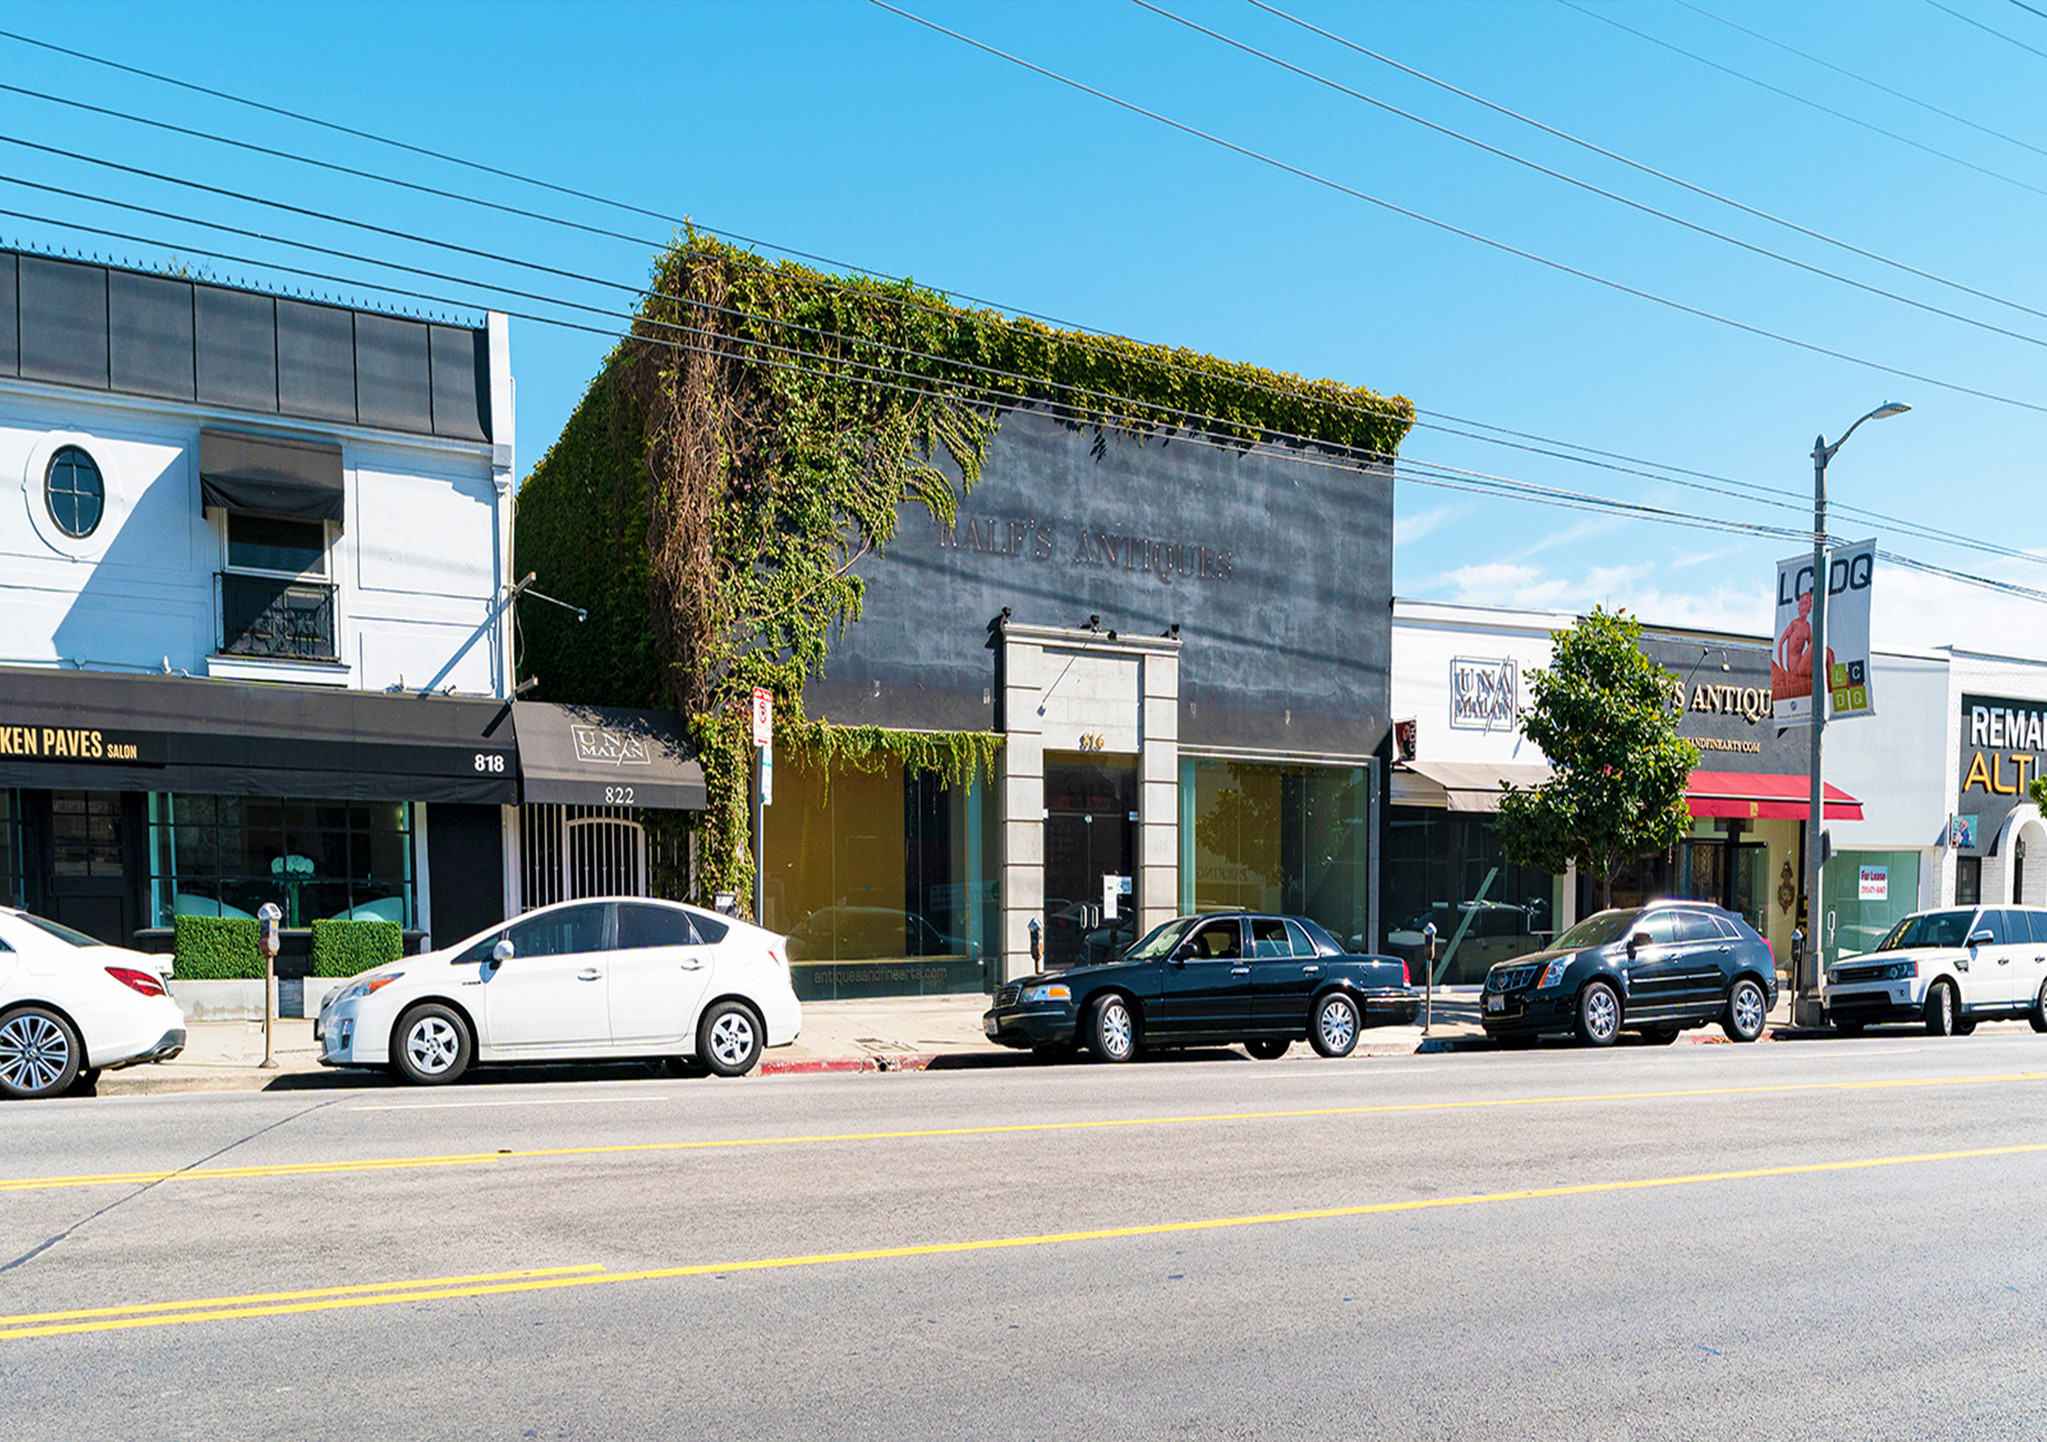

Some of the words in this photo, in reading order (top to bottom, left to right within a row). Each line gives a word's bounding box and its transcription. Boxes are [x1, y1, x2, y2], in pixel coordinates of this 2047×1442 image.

[1072, 531, 1233, 584] ANTIQUES
[1458, 668, 1512, 694] UNA
[1691, 684, 1775, 721] ANTIQU
[0, 726, 38, 755] KEN
[42, 728, 103, 758] PAVES
[107, 743, 137, 759] SALON
[577, 730, 641, 747] UNA
[1082, 733, 1105, 749] 816
[581, 745, 644, 759] MALAN
[474, 754, 505, 773] 818
[605, 786, 635, 804] 822
[1861, 870, 1870, 881] For
[1871, 871, 1886, 882] Lease
[815, 967, 947, 986] antiquesandfinearts.com
